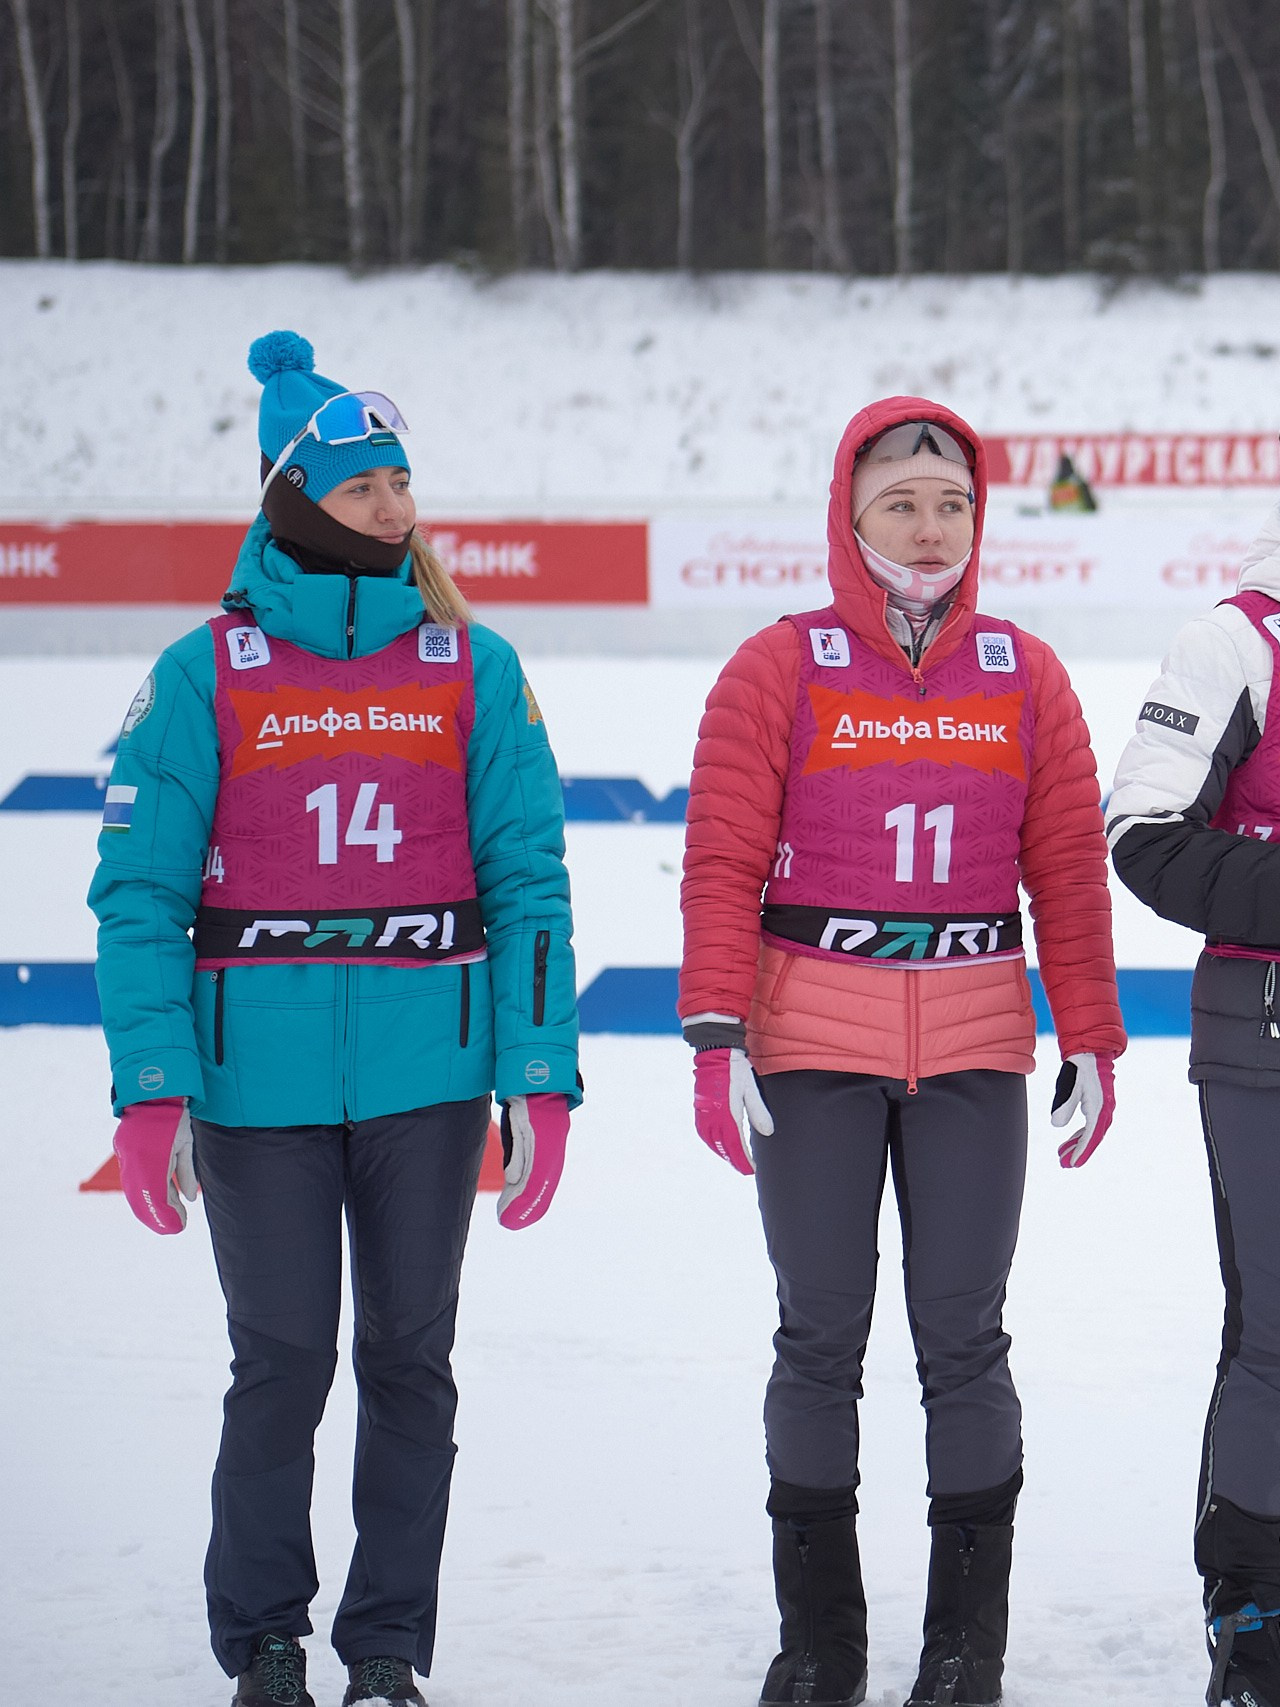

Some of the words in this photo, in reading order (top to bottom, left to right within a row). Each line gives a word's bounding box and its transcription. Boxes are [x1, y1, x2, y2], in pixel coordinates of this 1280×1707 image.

[425, 636, 450, 646] 2024
[426, 647, 451, 657] 2025
[983, 644, 1008, 655] 2024
[985, 656, 1009, 667] 2025
[257, 707, 362, 738] Альфа
[368, 707, 443, 734] Банк
[833, 714, 932, 745] Альфа
[937, 717, 1008, 743] Банк
[1143, 705, 1187, 729] MOAX
[306, 783, 402, 864] 14
[885, 804, 954, 883] 11
[774, 842, 795, 879] 11
[819, 917, 1004, 960] PARI
